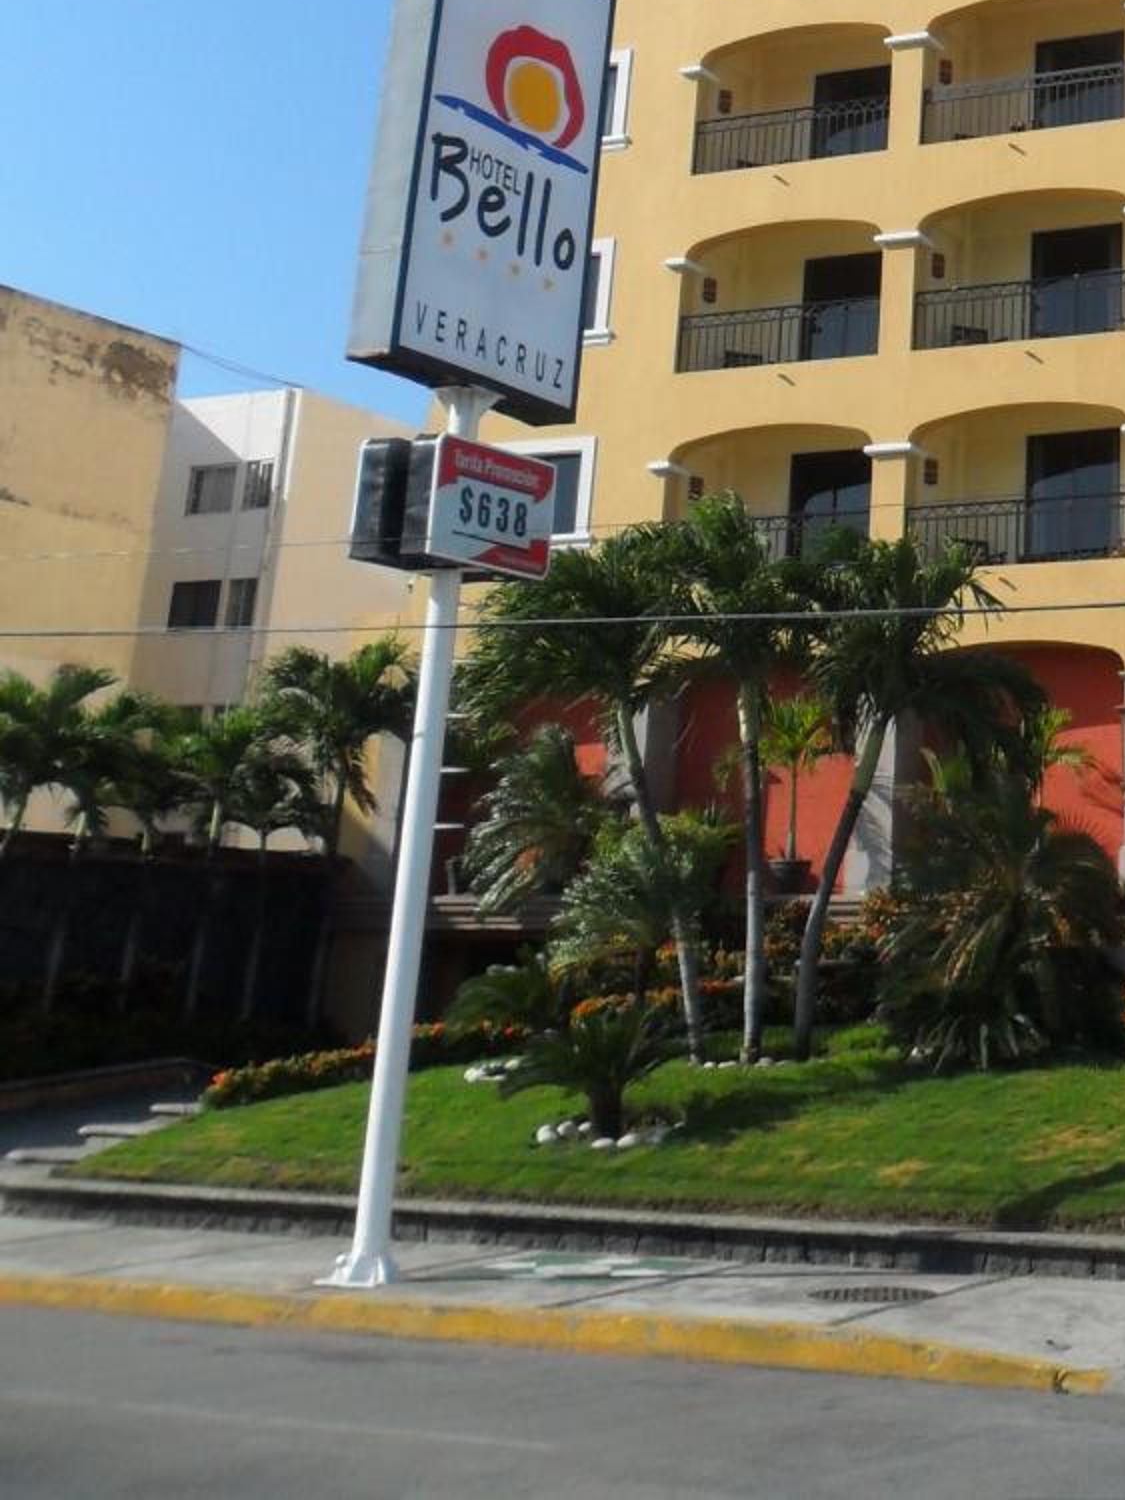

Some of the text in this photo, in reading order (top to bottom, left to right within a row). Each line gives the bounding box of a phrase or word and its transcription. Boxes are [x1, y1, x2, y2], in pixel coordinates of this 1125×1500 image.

[430, 132, 576, 271] Bello
[469, 145, 521, 196] HOTEL
[416, 300, 564, 389] VERACRUZ
[459, 484, 528, 538] $638
